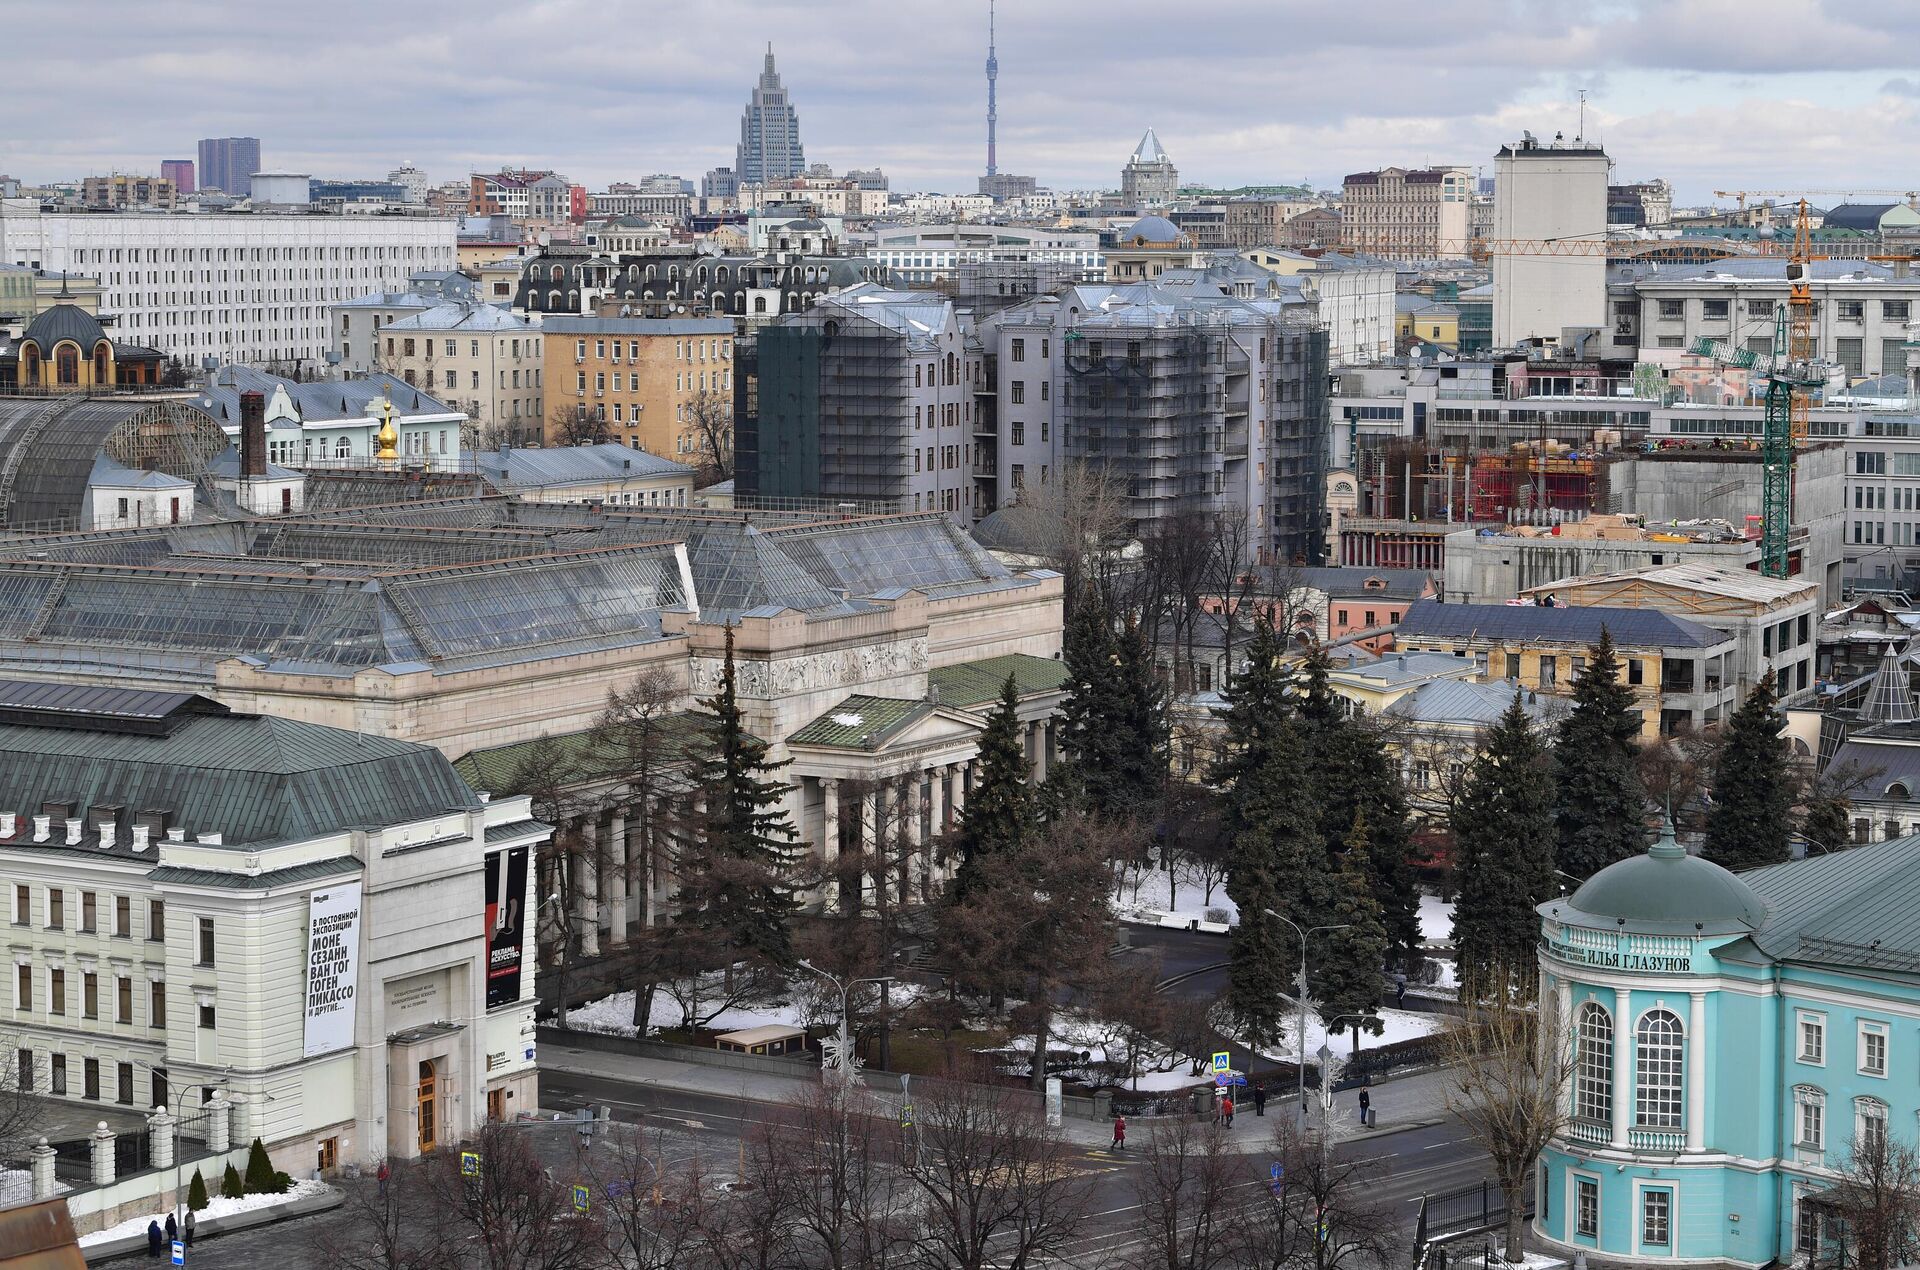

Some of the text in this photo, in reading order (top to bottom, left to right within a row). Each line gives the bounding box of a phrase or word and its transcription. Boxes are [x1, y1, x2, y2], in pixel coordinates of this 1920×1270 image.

[313, 910, 358, 927] В ПОСТОЯННОЙ
[312, 921, 352, 936] ЭКСПОЗИЦИИ
[312, 934, 341, 951] МОНЕ
[311, 947, 347, 965] СЕЗАНН
[492, 946, 515, 957] РЕКЛАМА
[310, 959, 350, 980] ВАН ГОГ
[1588, 950, 1690, 972] ИЛЬЯ ГЛАЗУНОВ
[309, 976, 337, 994] ГОГЕН
[309, 985, 354, 1008] ПИКАССО
[308, 1008, 314, 1017] И
